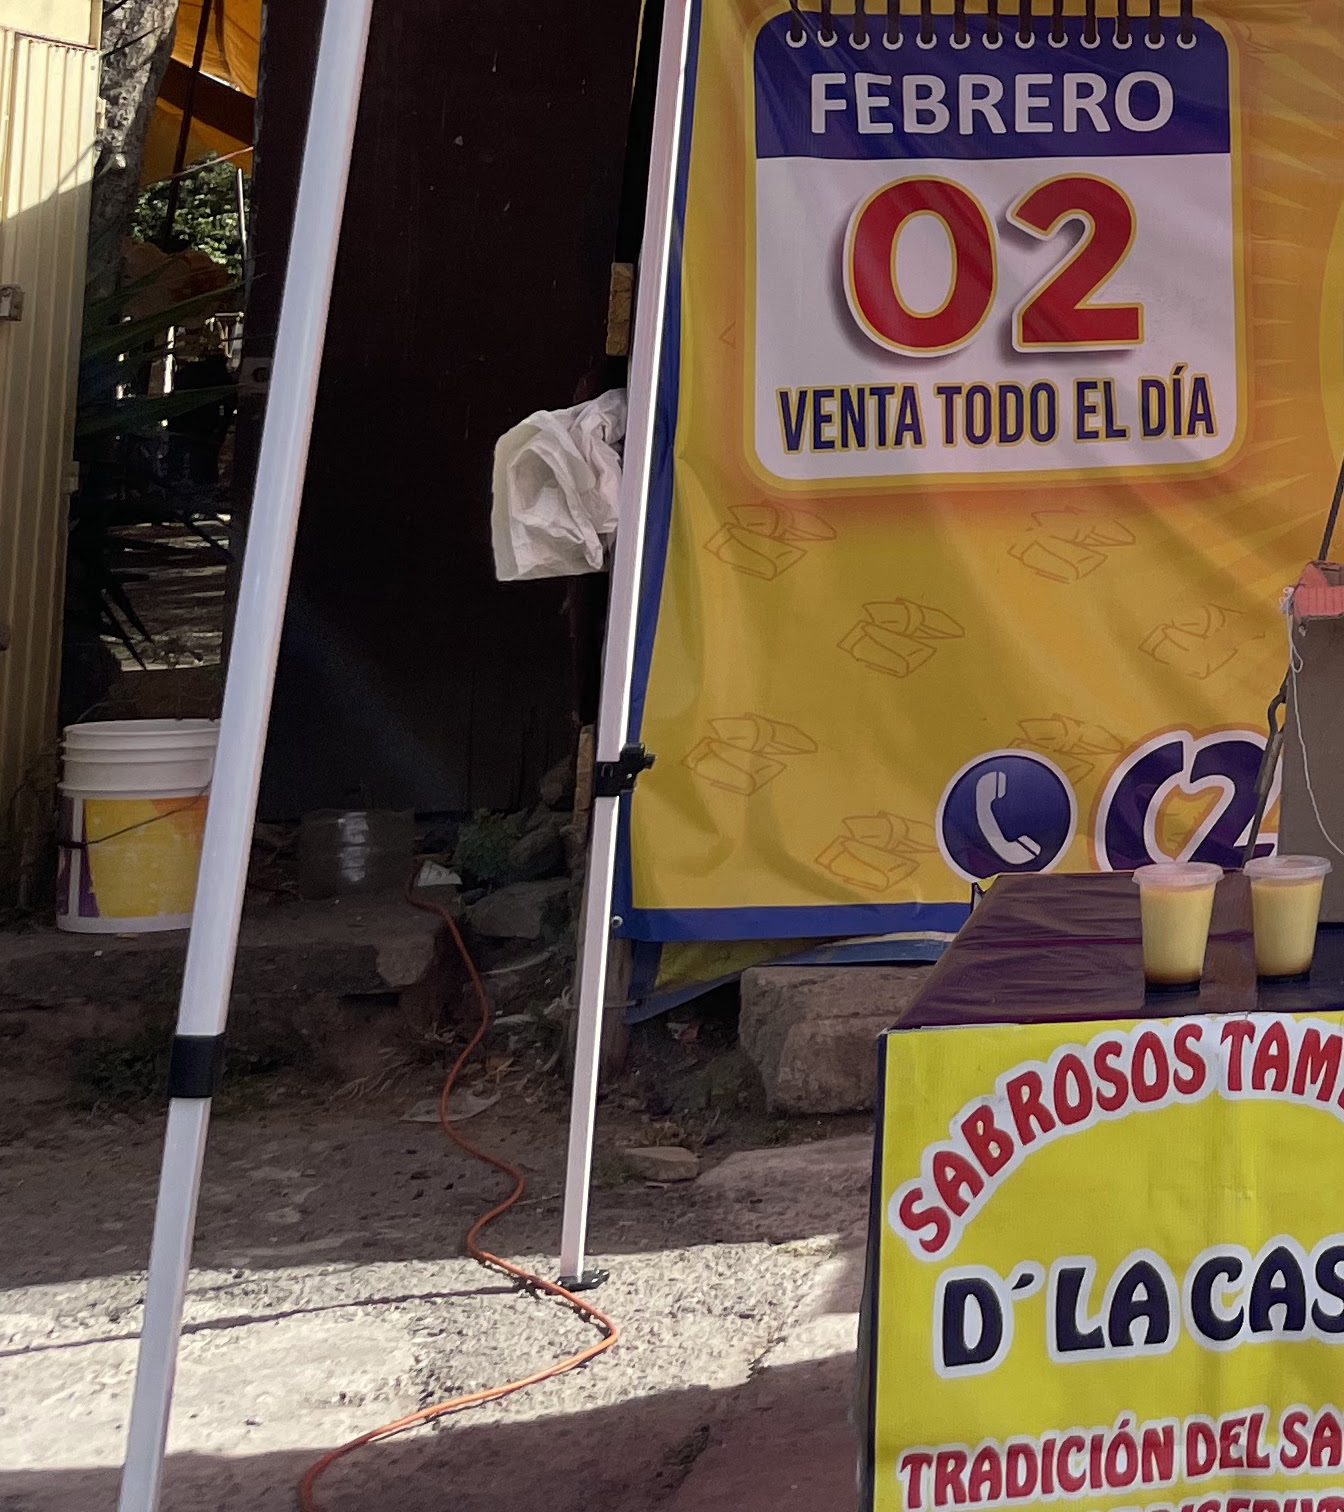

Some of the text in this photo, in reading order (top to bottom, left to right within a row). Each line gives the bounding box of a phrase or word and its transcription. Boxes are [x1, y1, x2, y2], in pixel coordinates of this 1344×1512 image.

[811, 71, 1174, 135] FEBRERO
[846, 175, 1143, 352] 02
[778, 364, 1215, 454] VENTA TODO EL DÍA
[899, 1024, 1206, 1253] SABROSOS
[901, 1419, 1174, 1509] TRADICIÓN
[1186, 1413, 1270, 1477] DEL
